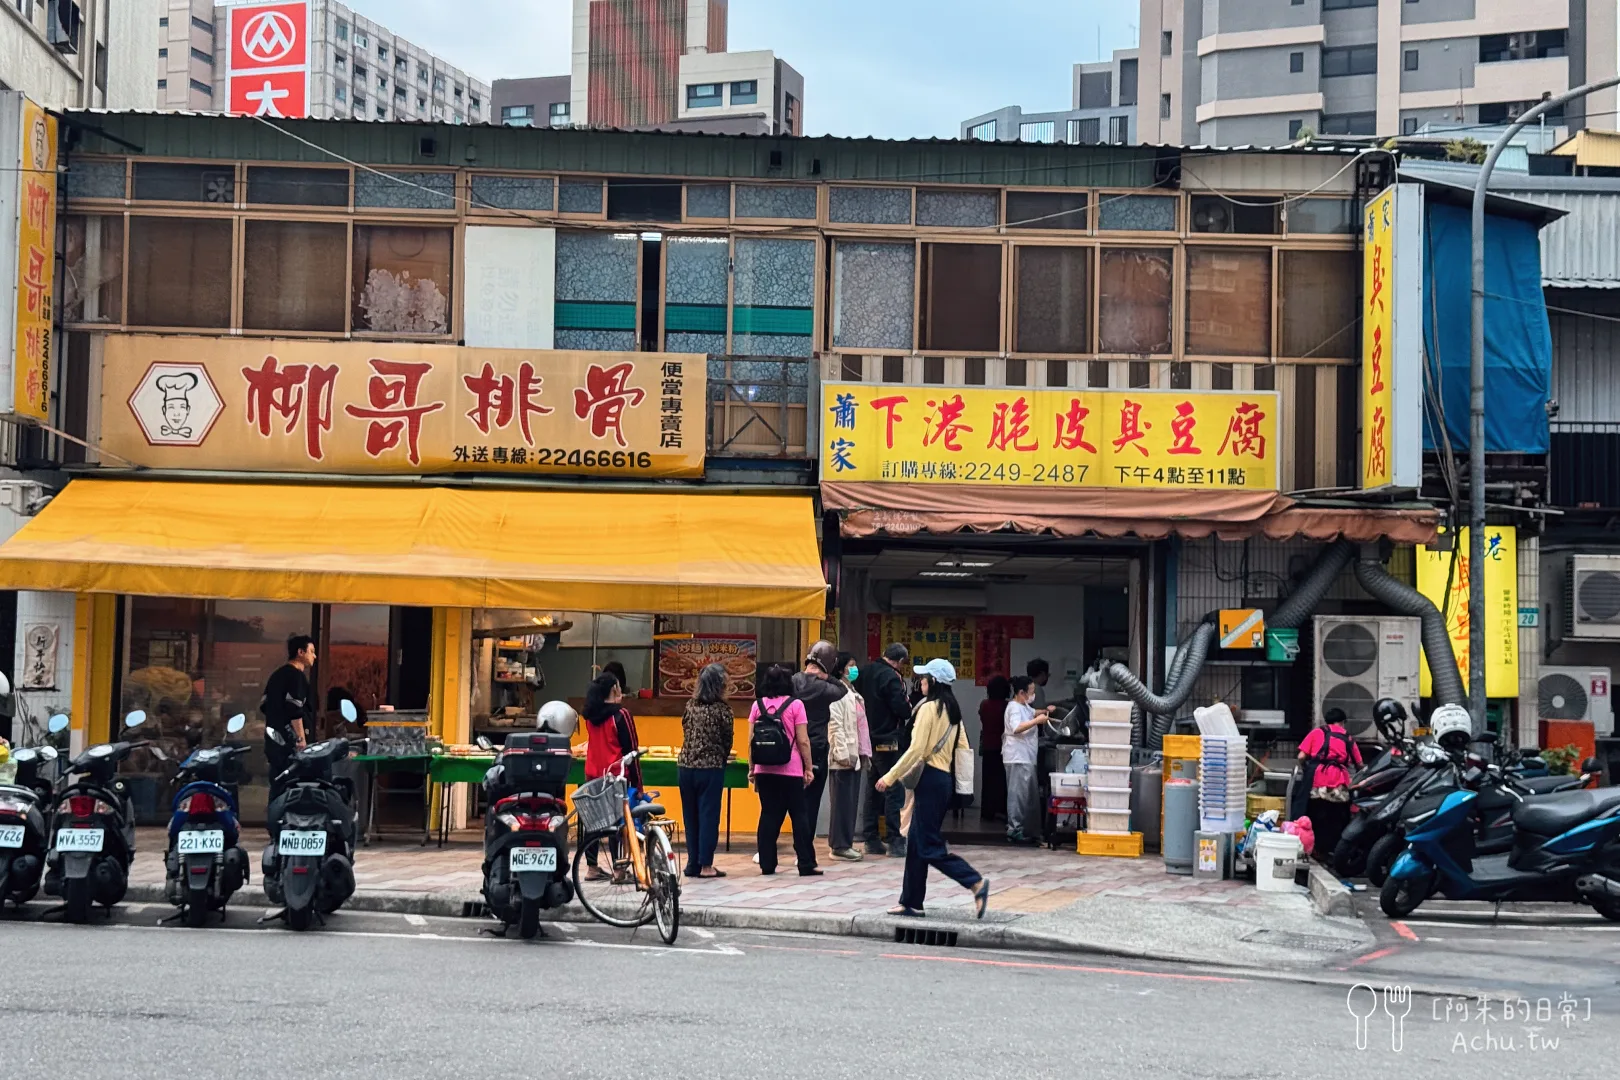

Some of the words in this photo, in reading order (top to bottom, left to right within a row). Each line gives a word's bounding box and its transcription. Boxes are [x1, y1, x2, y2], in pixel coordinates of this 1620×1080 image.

[246, 80, 290, 118] 大
[1366, 244, 1386, 480] 臭豆腐
[241, 355, 646, 466] 柳哥排骨
[660, 361, 683, 448] 便當專賣店
[829, 393, 859, 473] 蕭家
[870, 394, 1266, 460] 下港脆皮臭豆腐
[1114, 465, 1245, 485] 下午4點至11點
[1521, 614, 1534, 624] 20
[709, 643, 738, 654] 炒米粉
[180, 838, 221, 850] 221-KXG
[512, 853, 555, 865] MQE-9676
